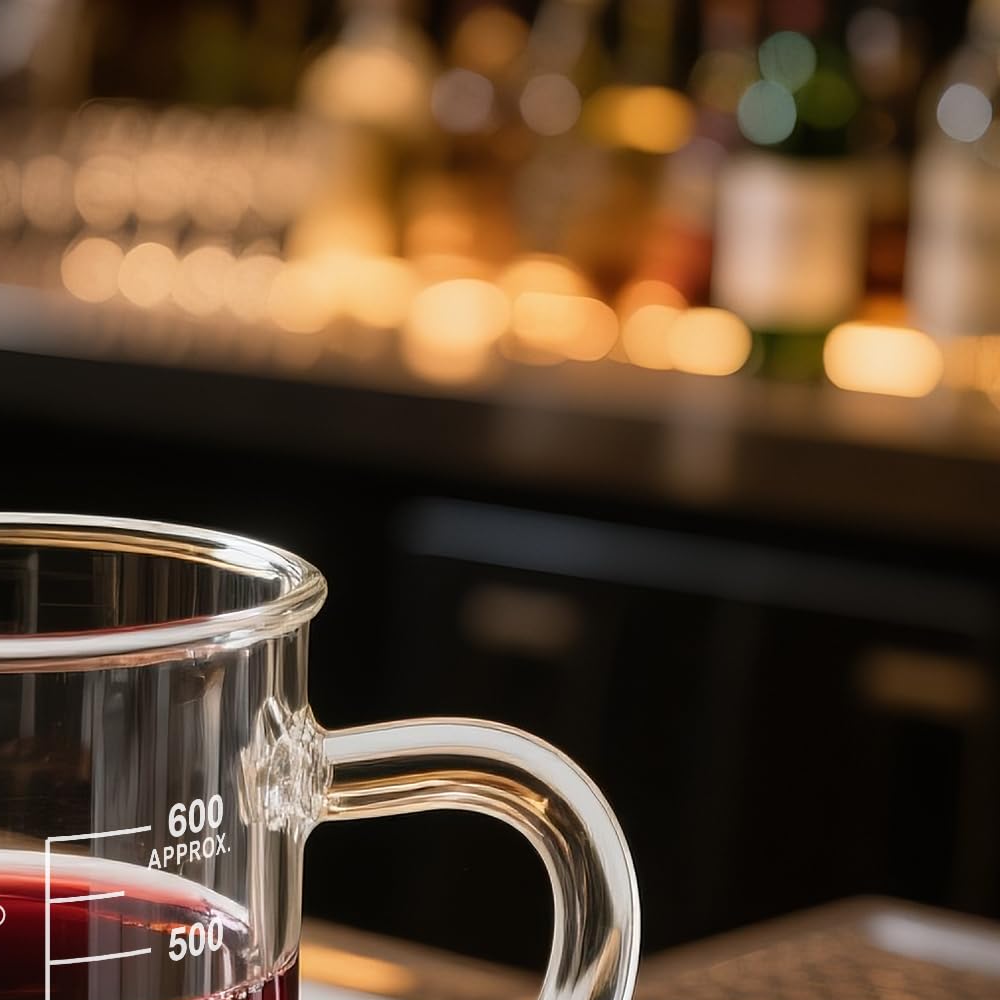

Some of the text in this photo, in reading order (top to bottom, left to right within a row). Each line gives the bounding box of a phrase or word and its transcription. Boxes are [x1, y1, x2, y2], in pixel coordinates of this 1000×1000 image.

[168, 794, 224, 838] 600
[148, 833, 231, 870] APPROX.
[168, 918, 224, 962] 500
